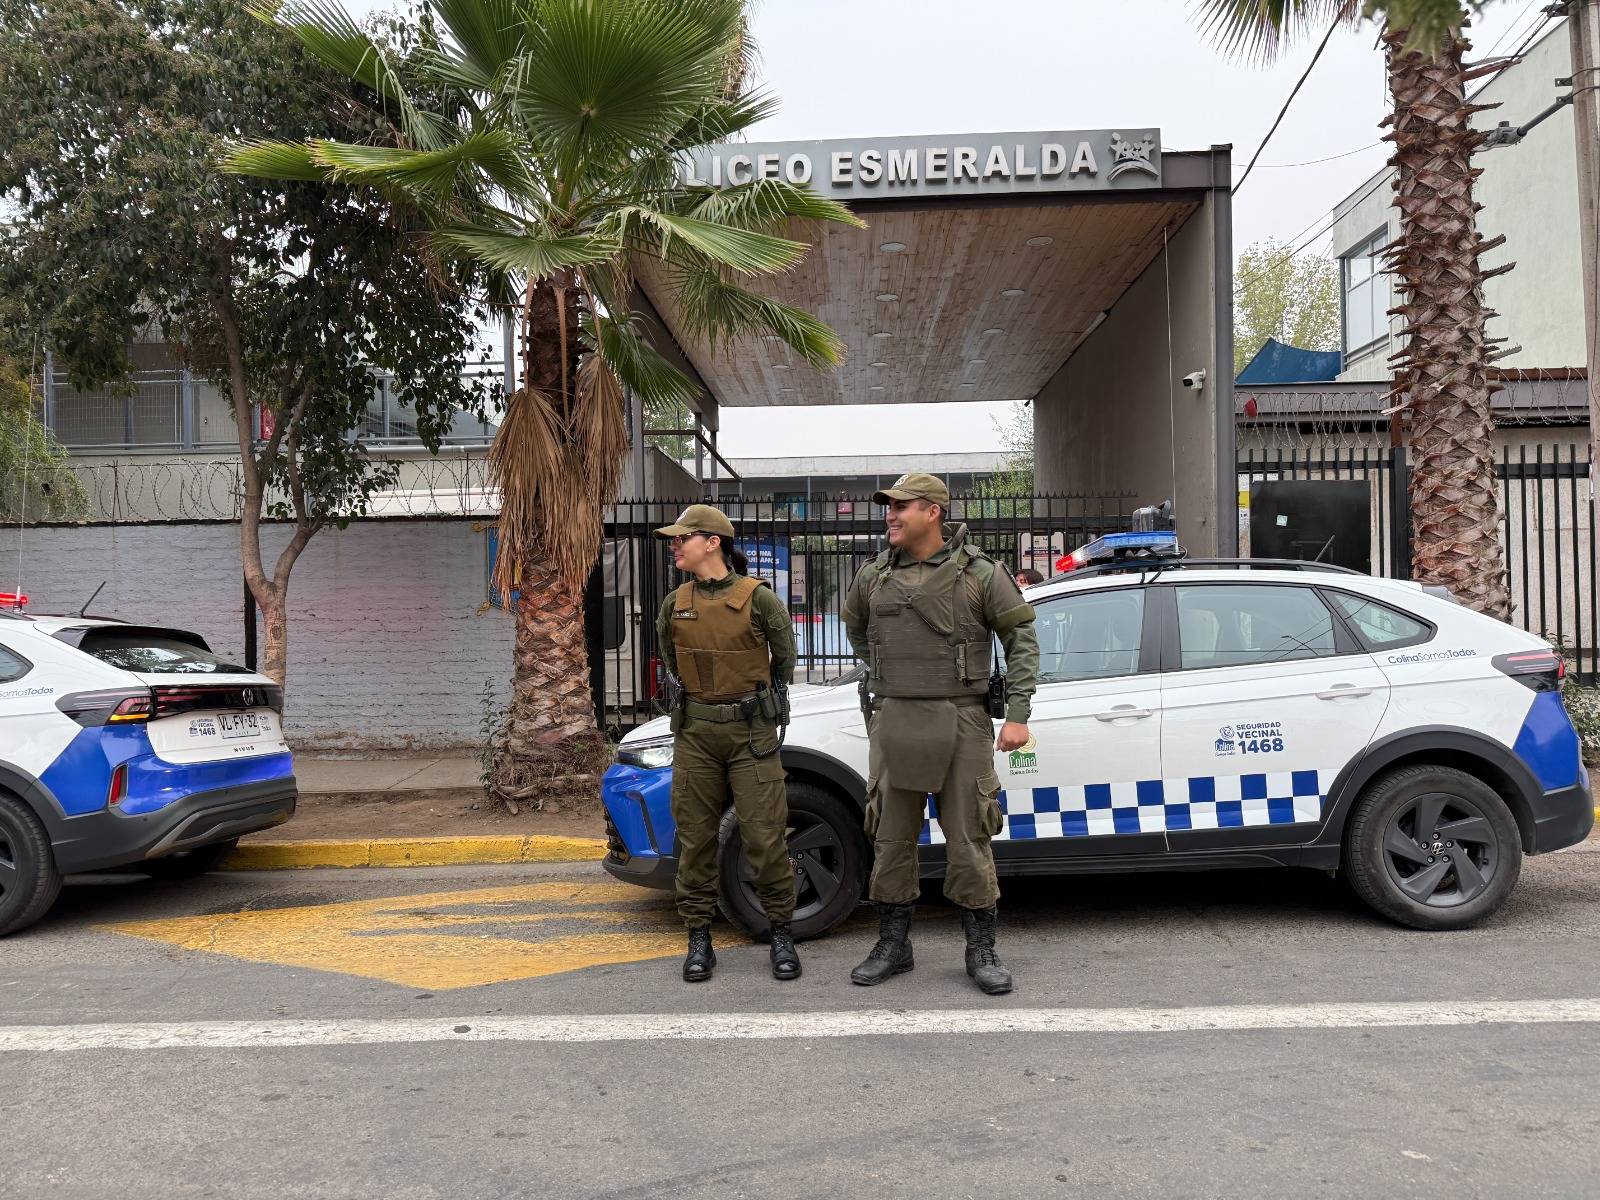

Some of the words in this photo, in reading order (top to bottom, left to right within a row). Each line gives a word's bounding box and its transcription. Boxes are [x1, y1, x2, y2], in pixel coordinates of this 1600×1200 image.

[686, 153, 813, 188] LICEO
[832, 142, 1098, 186] ESMERALDA
[1388, 648, 1477, 664] ColinaSomosTodos
[198, 727, 216, 736] 1468
[1236, 722, 1281, 730] SEGURIDAD
[1237, 729, 1283, 739] VECINAL
[1238, 738, 1284, 754] 1468
[1010, 755, 1036, 768] Colina
